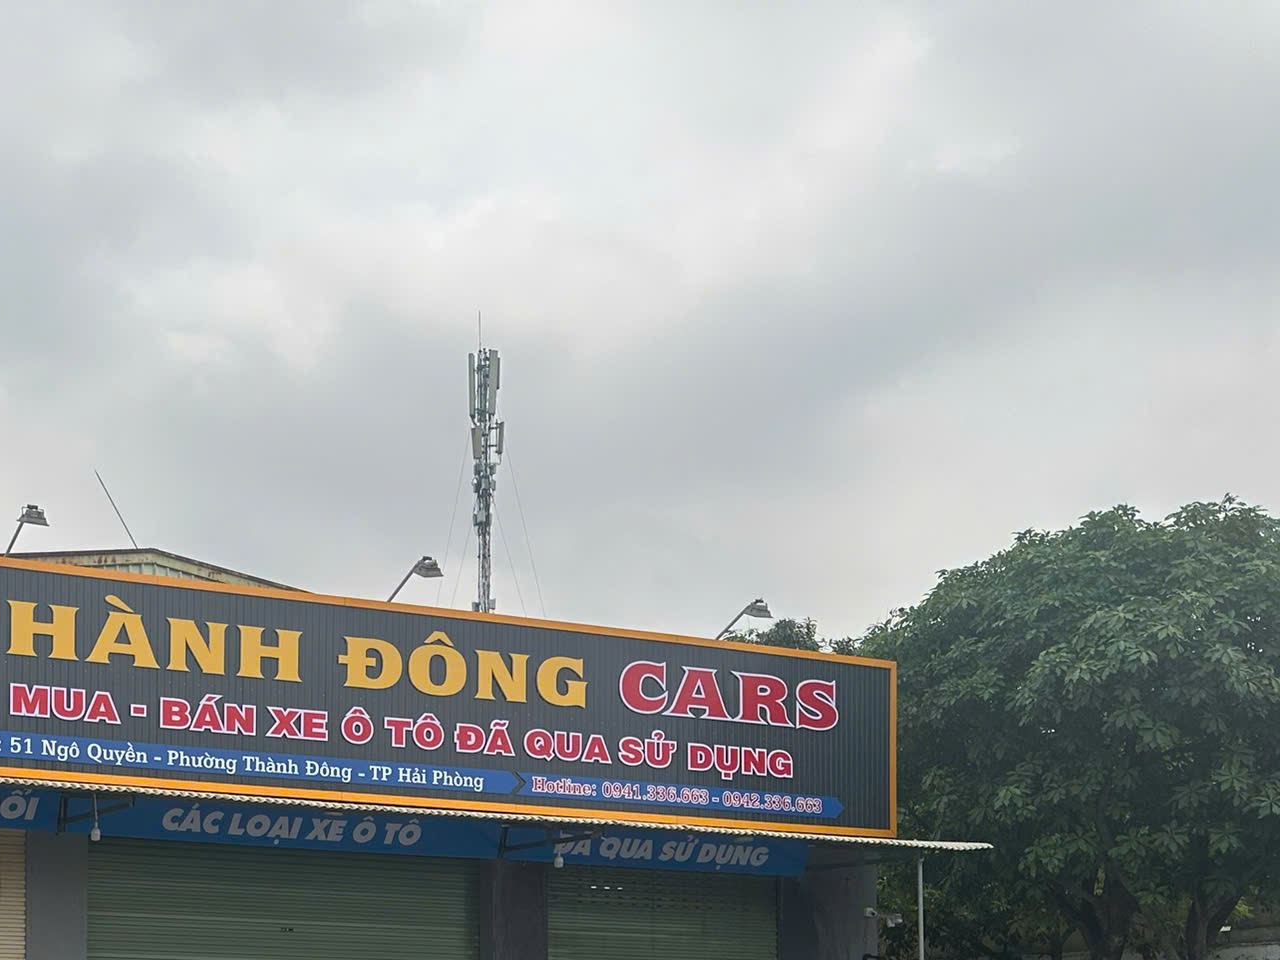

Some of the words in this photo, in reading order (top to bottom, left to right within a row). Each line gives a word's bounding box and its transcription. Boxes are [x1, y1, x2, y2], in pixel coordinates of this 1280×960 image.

[338, 631, 588, 708] ĐÔNG
[619, 660, 839, 732] CARS
[10, 682, 121, 724] MUA
[159, 694, 256, 736] BÁN
[266, 706, 328, 741] XE
[340, 706, 374, 744] Ô
[384, 714, 446, 750] TÔ
[453, 720, 516, 757] ĐÃ
[523, 729, 612, 764] QUA
[618, 730, 677, 768] SỬ
[688, 744, 794, 780] DỤNG
[10, 738, 33, 754] 51
[41, 739, 80, 762] Ngô
[87, 742, 148, 766] Quyền
[167, 750, 238, 774] Phường
[242, 756, 299, 776] Thành
[305, 760, 352, 783] Đông
[370, 765, 392, 781] TP
[398, 767, 426, 784] Hải
[432, 770, 484, 792] Phòng
[532, 776, 598, 796] Hotline:
[602, 782, 709, 804] 0941.336.663
[722, 790, 822, 814] 0942.336.663
[162, 803, 224, 834] CÁC
[228, 812, 303, 845] LOẠI
[304, 818, 349, 842] XE
[352, 816, 377, 843] Ô
[383, 818, 422, 846] TÔ
[600, 836, 653, 860] QUA
[658, 834, 700, 861] SỬ
[696, 844, 769, 870] DỤNG
